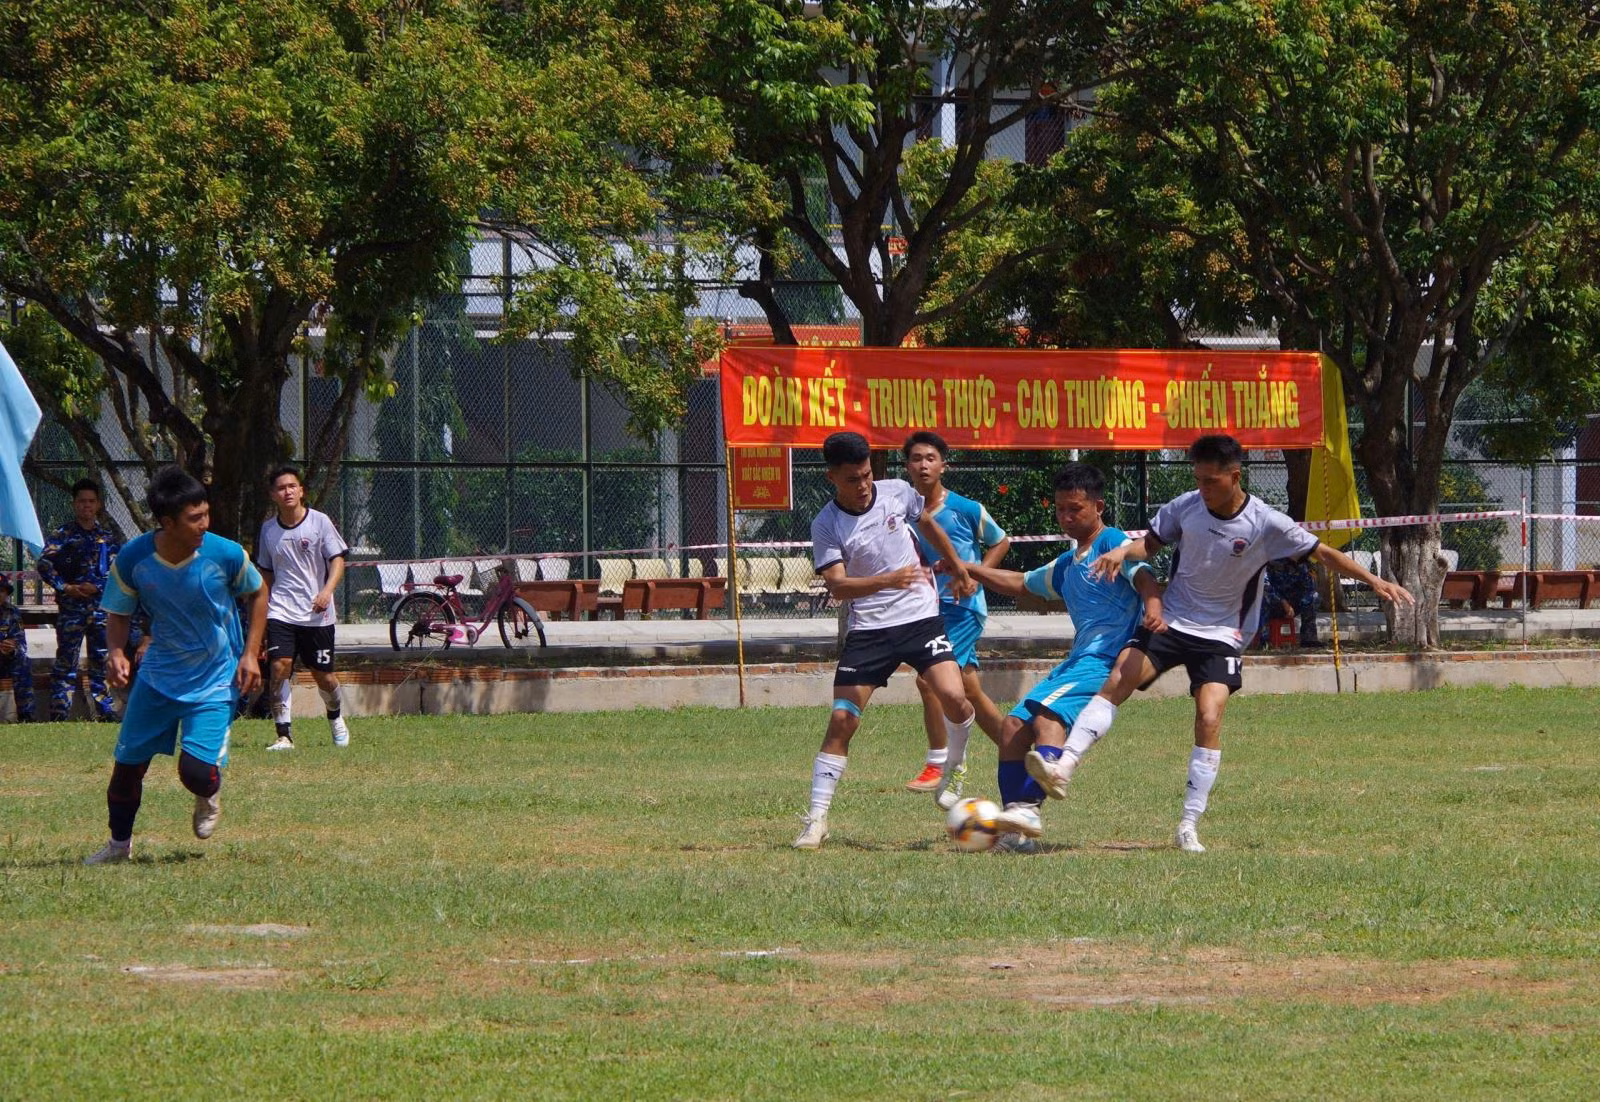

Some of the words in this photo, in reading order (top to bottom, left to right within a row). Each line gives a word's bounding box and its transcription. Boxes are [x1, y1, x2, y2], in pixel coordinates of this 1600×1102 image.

[742, 366, 802, 427] ĐOÀN
[808, 359, 848, 428] KẾT
[867, 377, 937, 429] TRUNG
[943, 373, 997, 440] THỰC
[1017, 379, 1059, 430] CAO
[1064, 375, 1147, 441] THƯỢNG
[1165, 362, 1228, 429] CHIẾN
[1232, 363, 1300, 429] THẮNG
[316, 649, 331, 665] 15
[925, 634, 953, 657] 25
